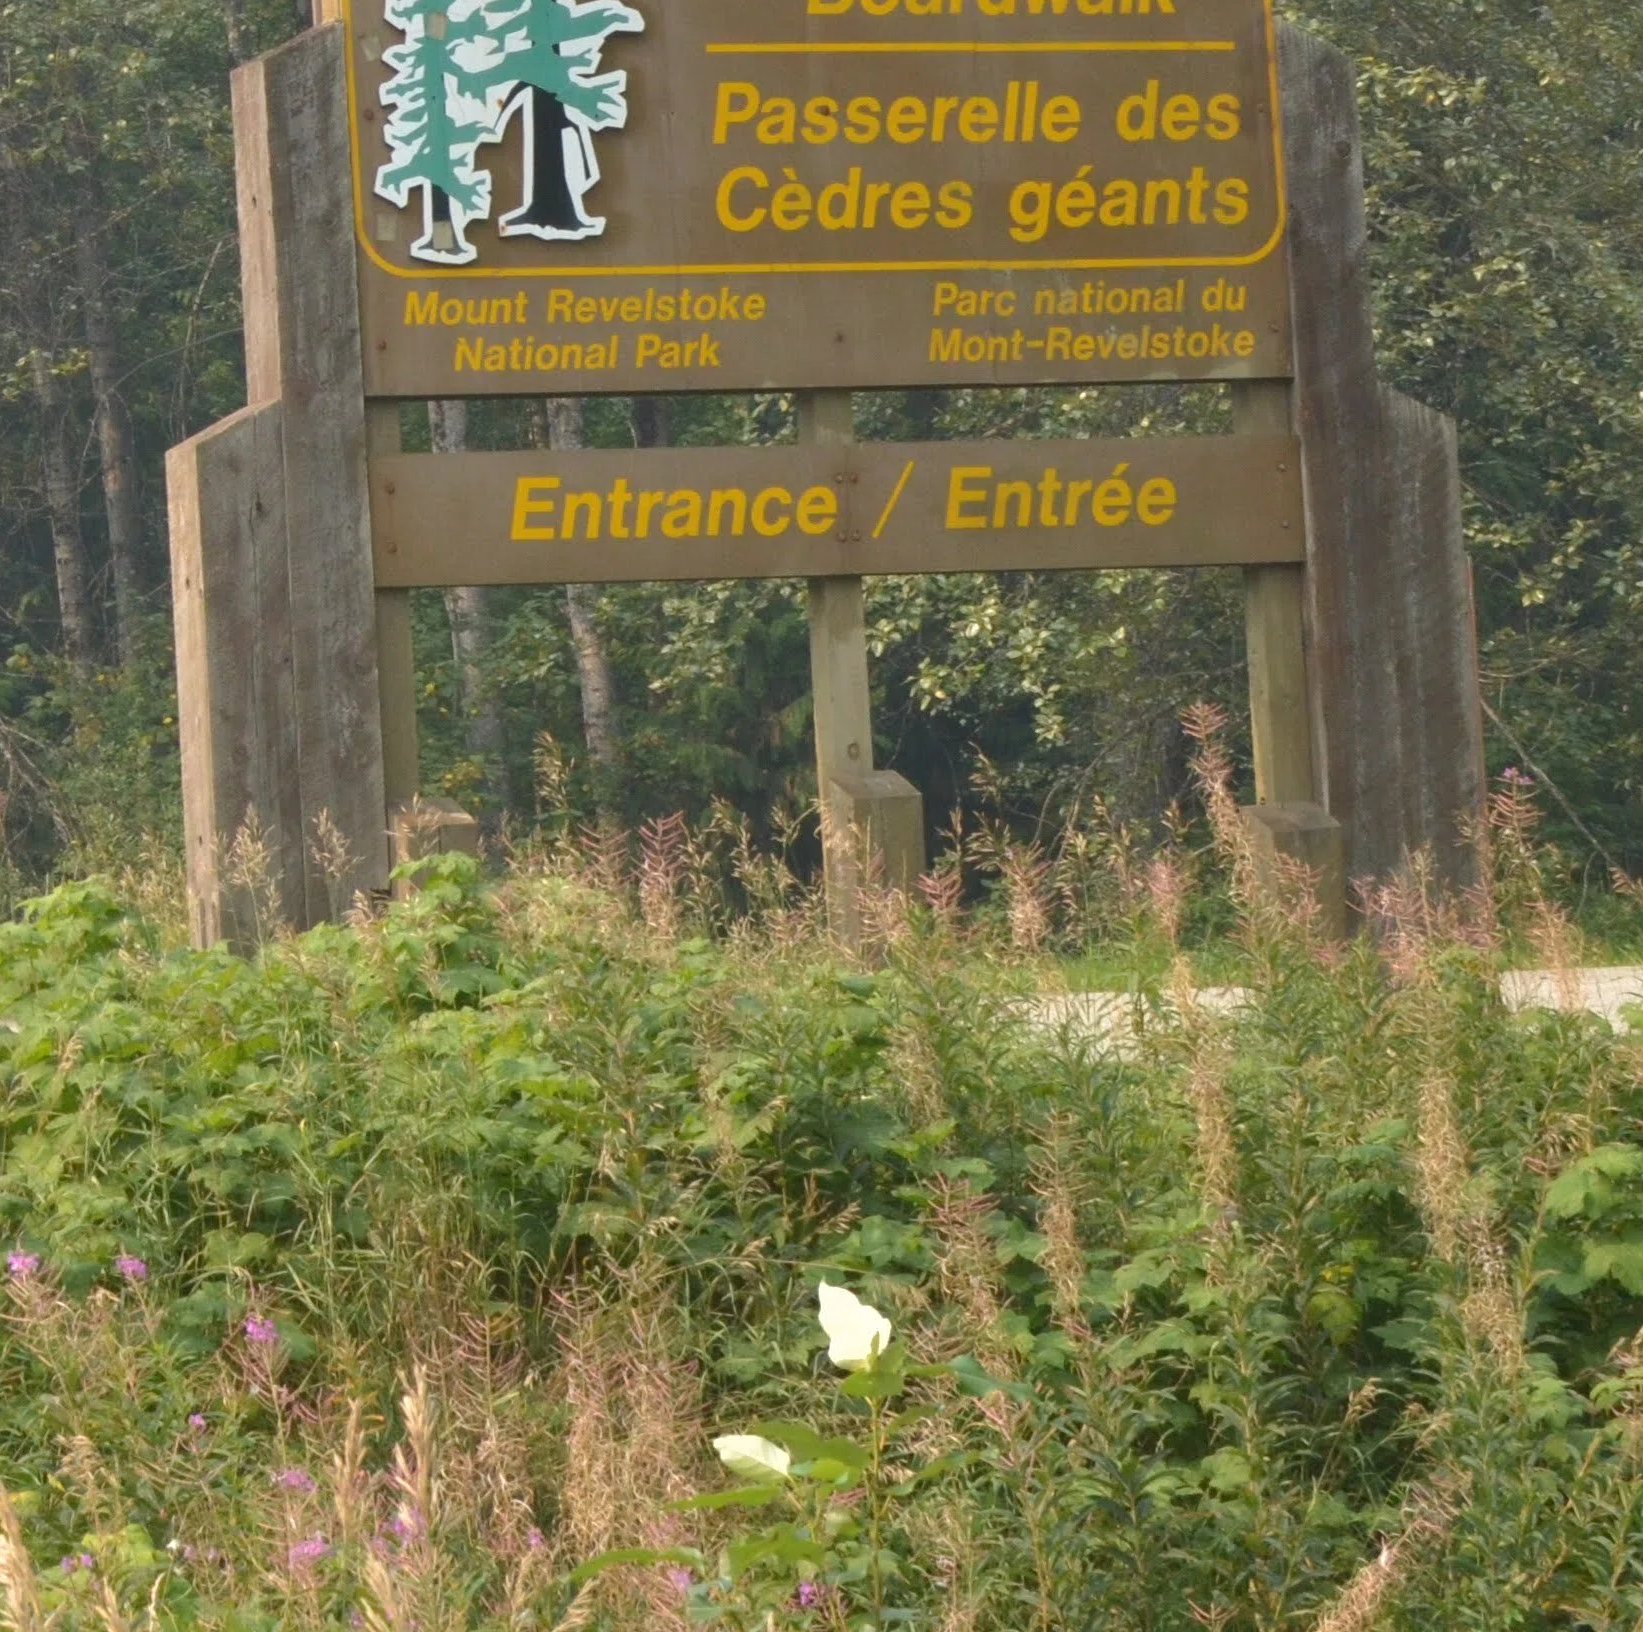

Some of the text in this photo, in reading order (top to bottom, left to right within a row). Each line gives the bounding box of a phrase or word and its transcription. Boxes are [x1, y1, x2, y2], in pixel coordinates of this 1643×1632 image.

[712, 78, 1242, 145] Passerelle des
[714, 163, 1250, 243] Cèdres géants
[402, 285, 769, 328] Mount Revelstoke
[931, 276, 1248, 318] Parc national du
[452, 330, 722, 374] National Park
[927, 325, 1257, 364] Mont-Revelstoke
[508, 460, 1178, 544] Entrance / Entrée
